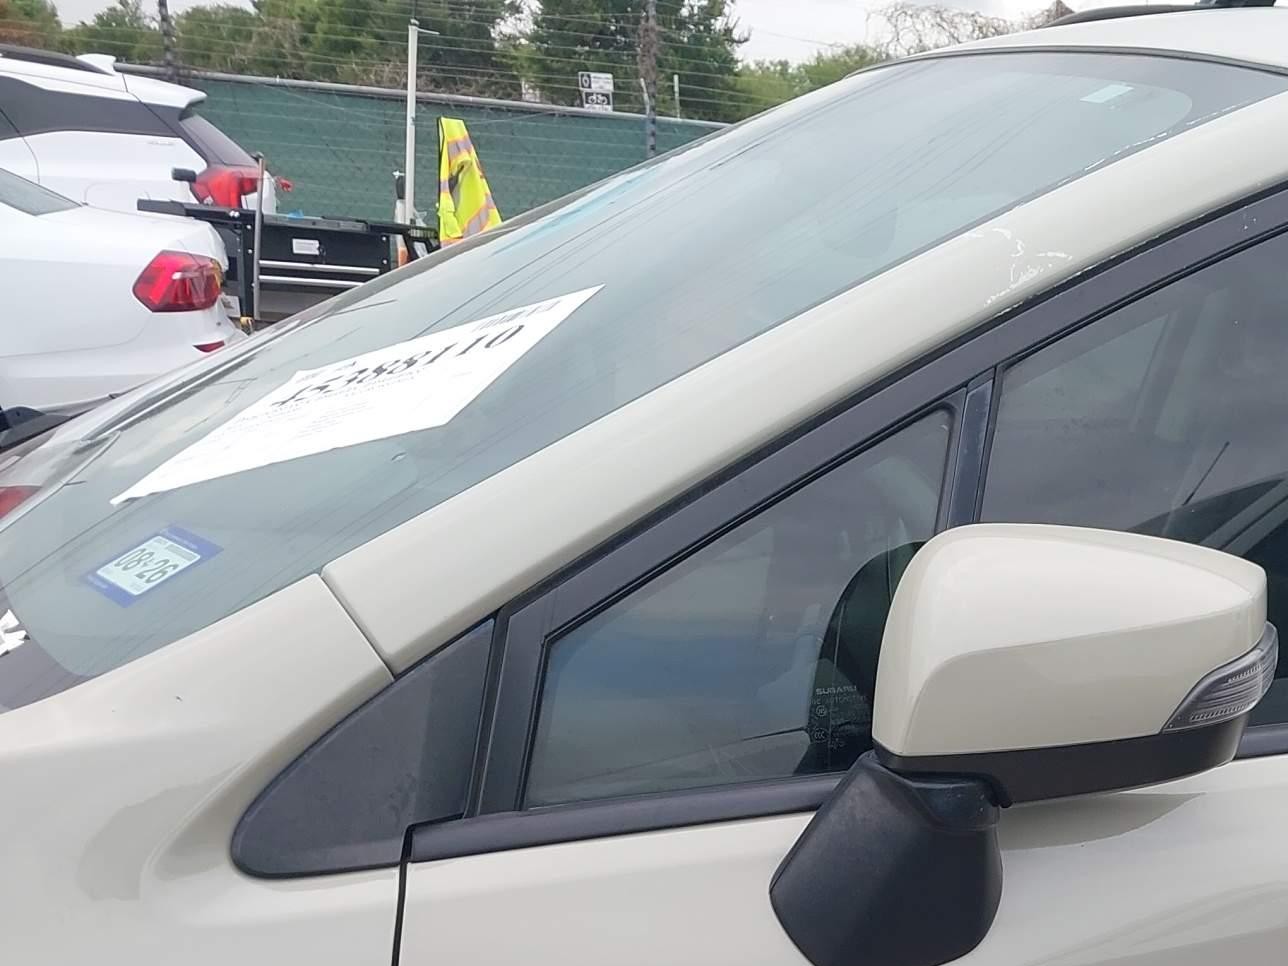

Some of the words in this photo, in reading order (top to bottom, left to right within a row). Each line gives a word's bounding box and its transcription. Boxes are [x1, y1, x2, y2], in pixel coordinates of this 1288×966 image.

[270, 324, 526, 409] 45388110
[134, 558, 180, 584] 26
[815, 685, 857, 695] SUBARU
